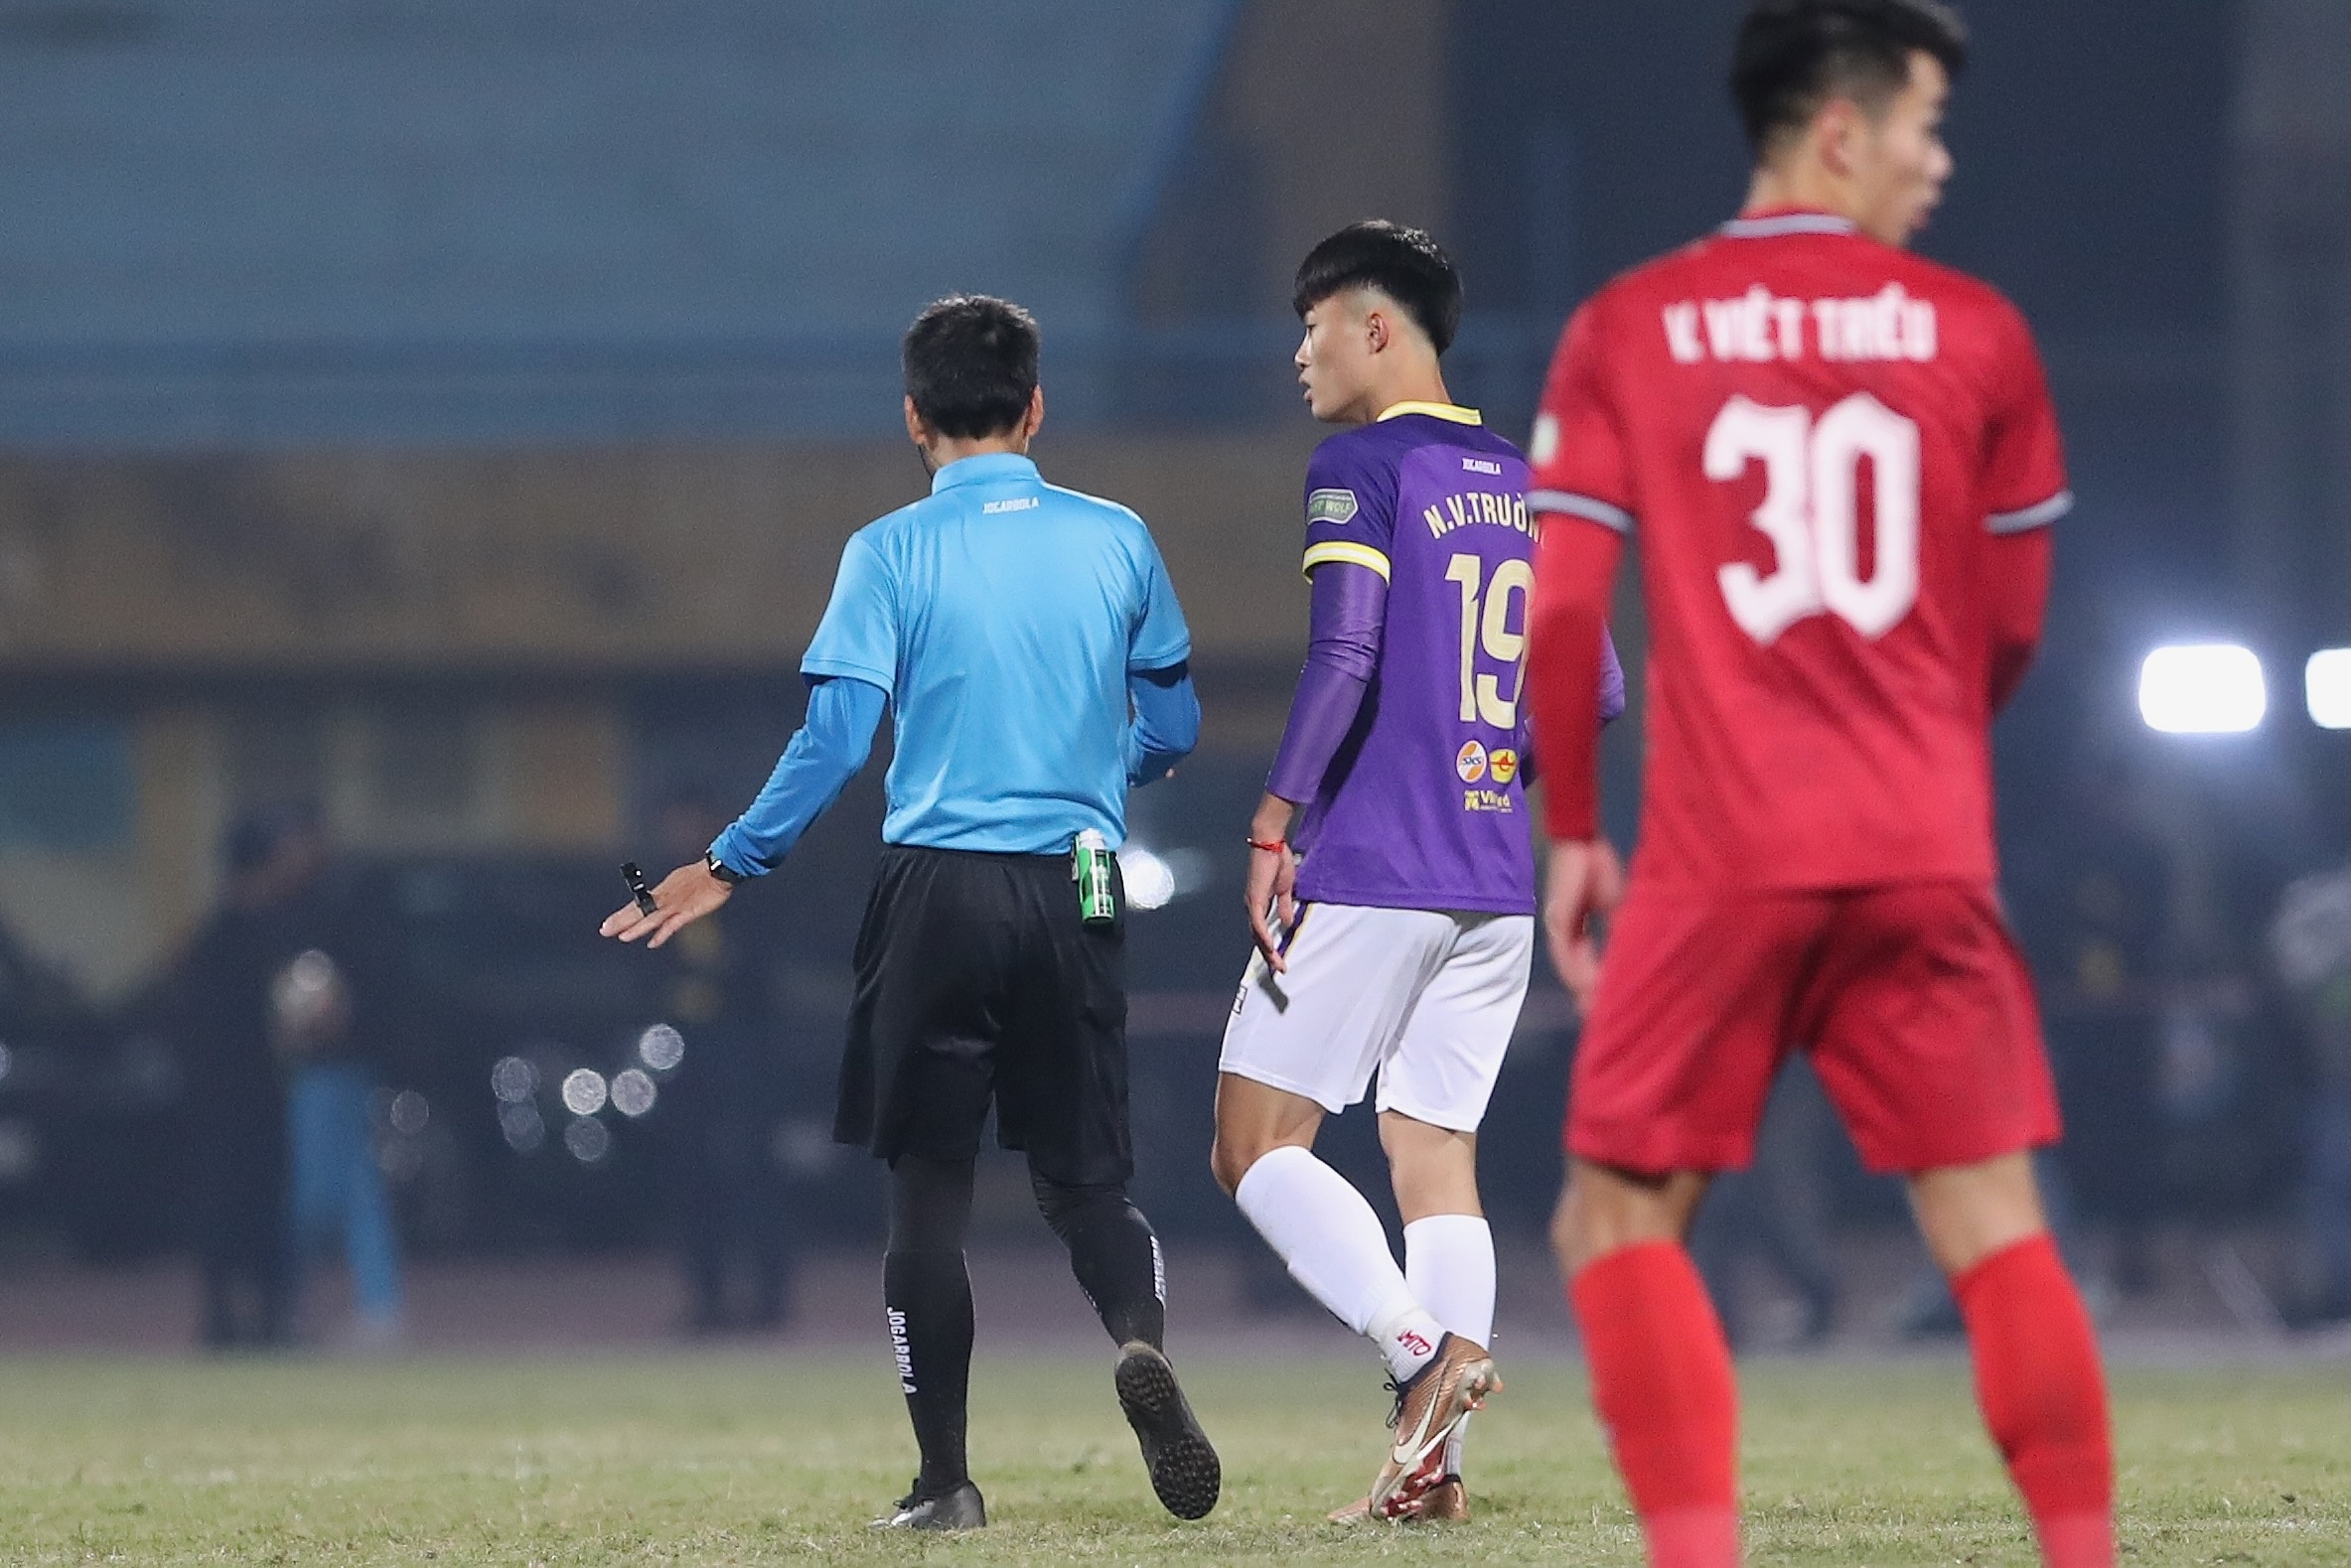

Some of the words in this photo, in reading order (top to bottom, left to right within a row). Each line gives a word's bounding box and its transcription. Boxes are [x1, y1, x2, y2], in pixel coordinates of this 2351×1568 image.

[1701, 390, 1921, 645] 30
[1444, 553, 1537, 730] 19
[887, 1306, 917, 1393] JOGARBOLA
